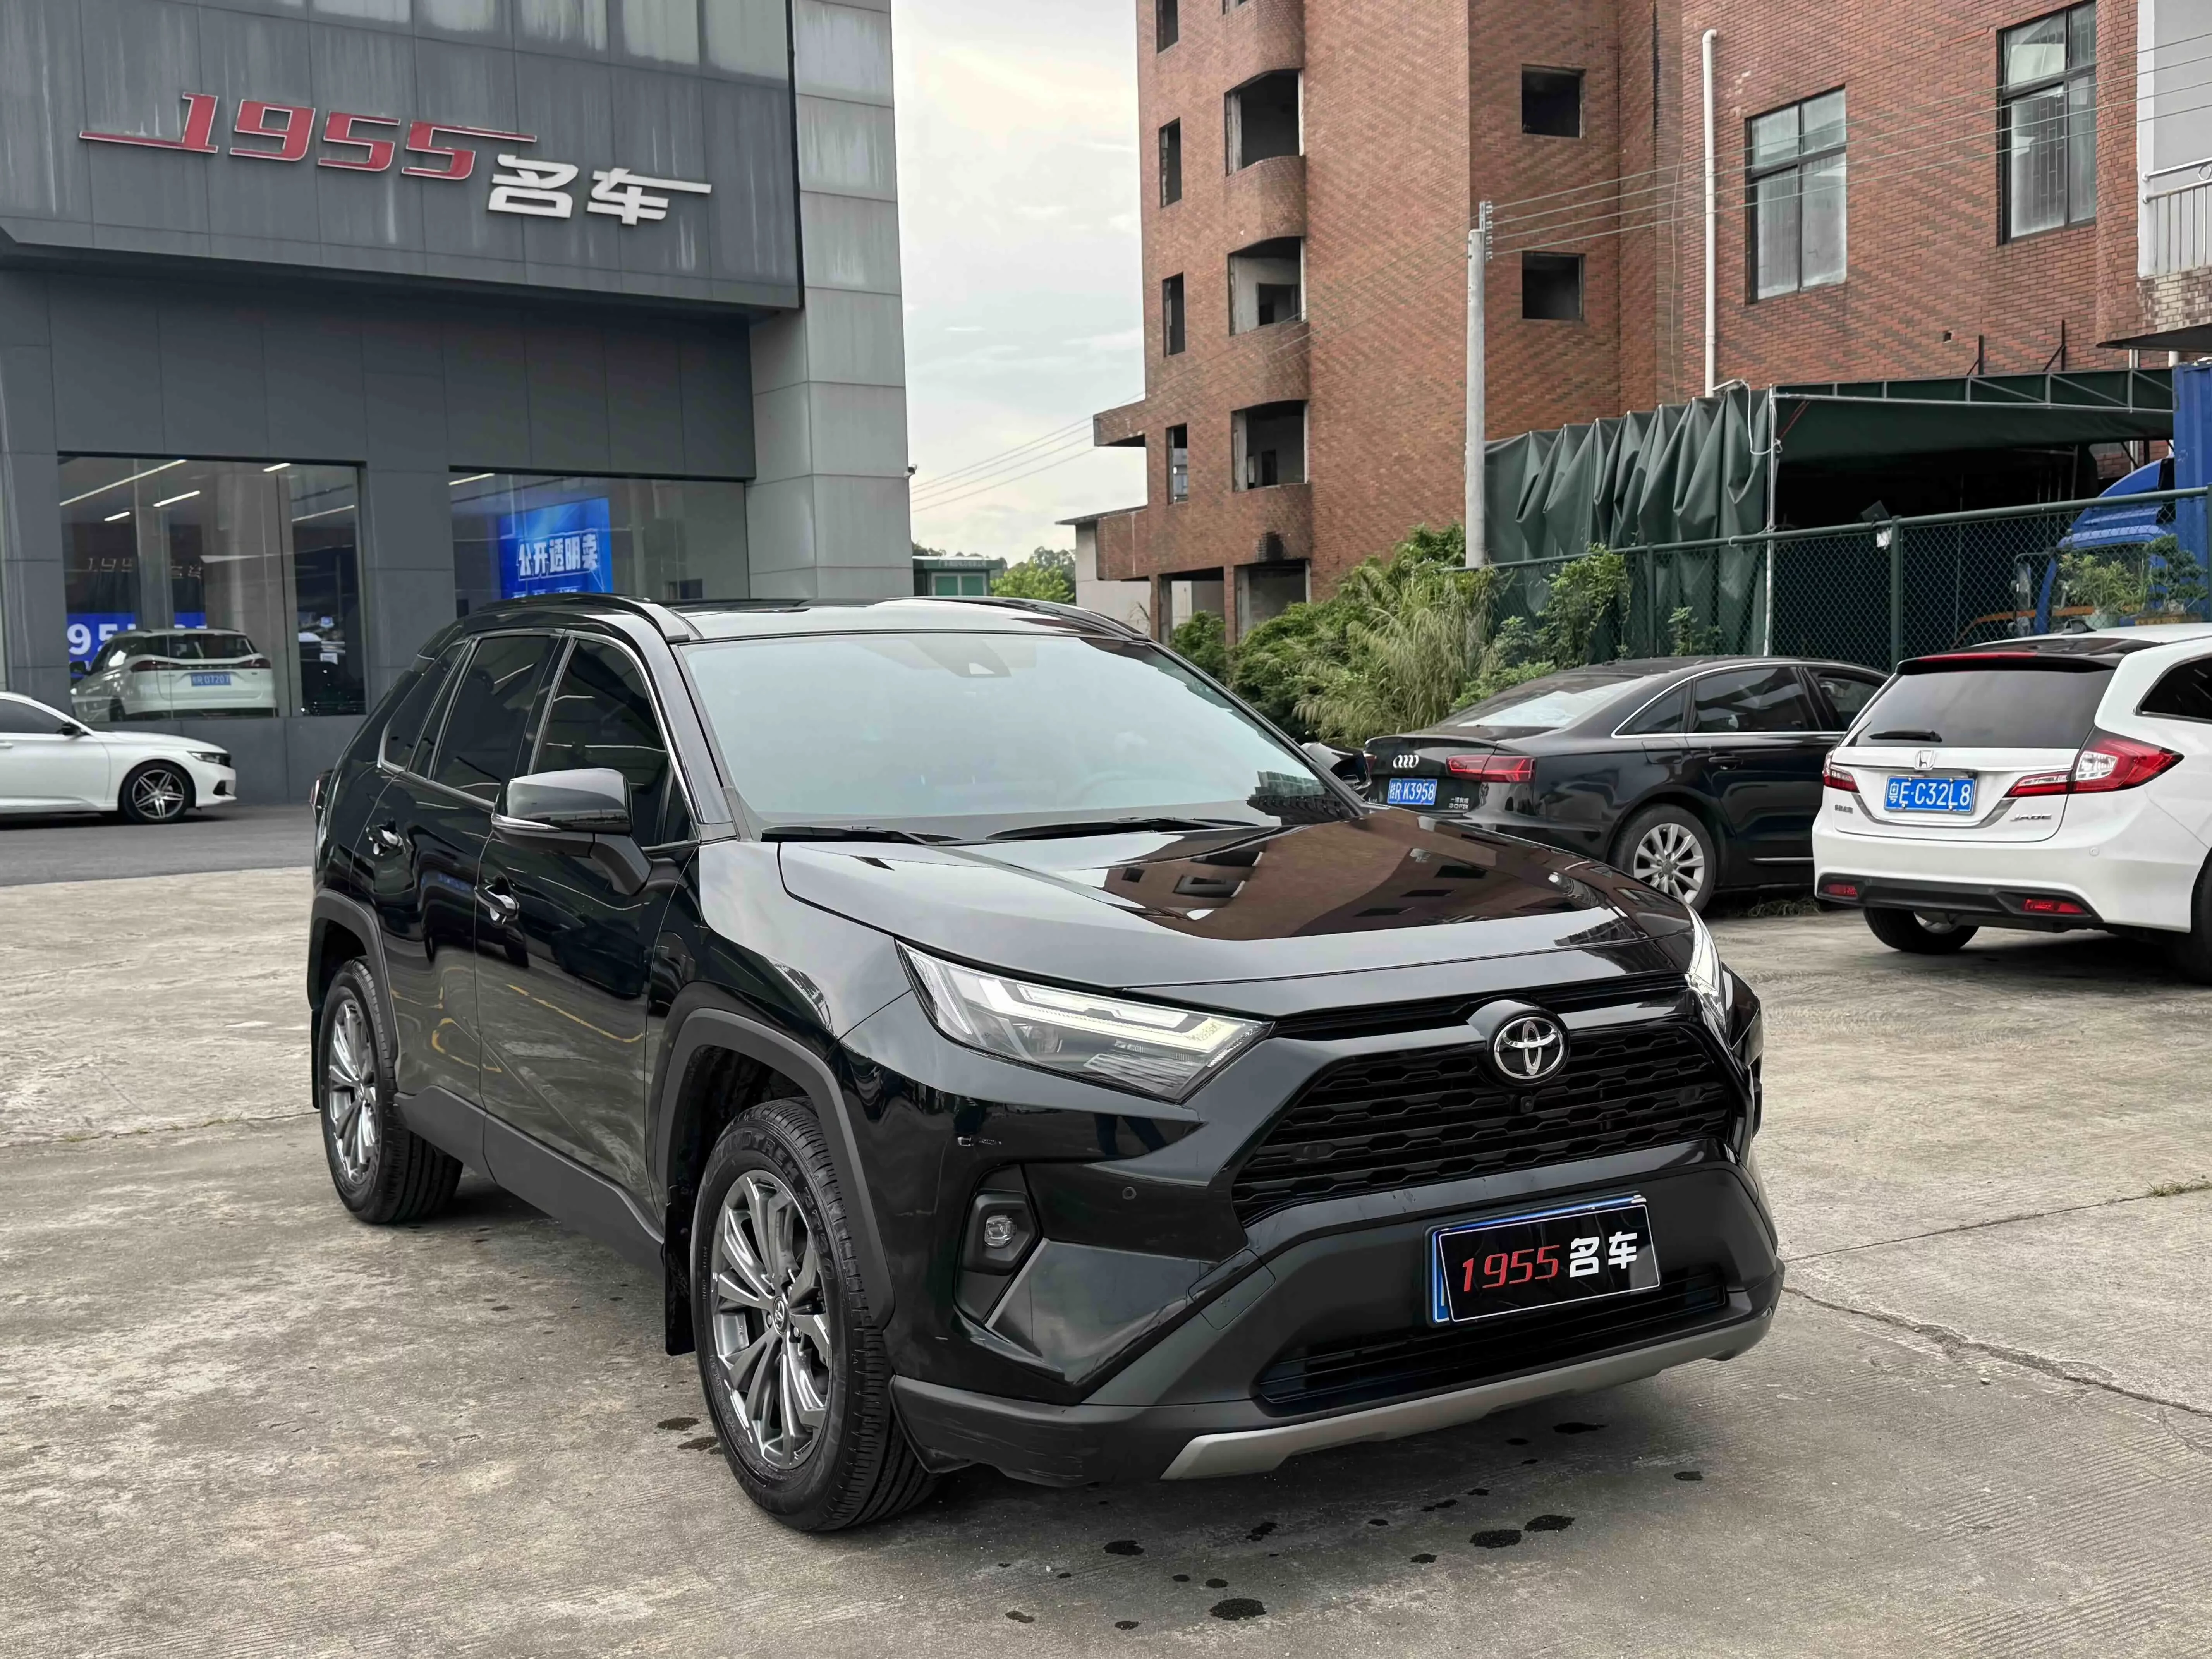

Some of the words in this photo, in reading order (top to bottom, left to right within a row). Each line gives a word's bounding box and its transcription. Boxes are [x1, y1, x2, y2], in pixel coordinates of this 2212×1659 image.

[519, 533, 598, 576] 公开透明卖
